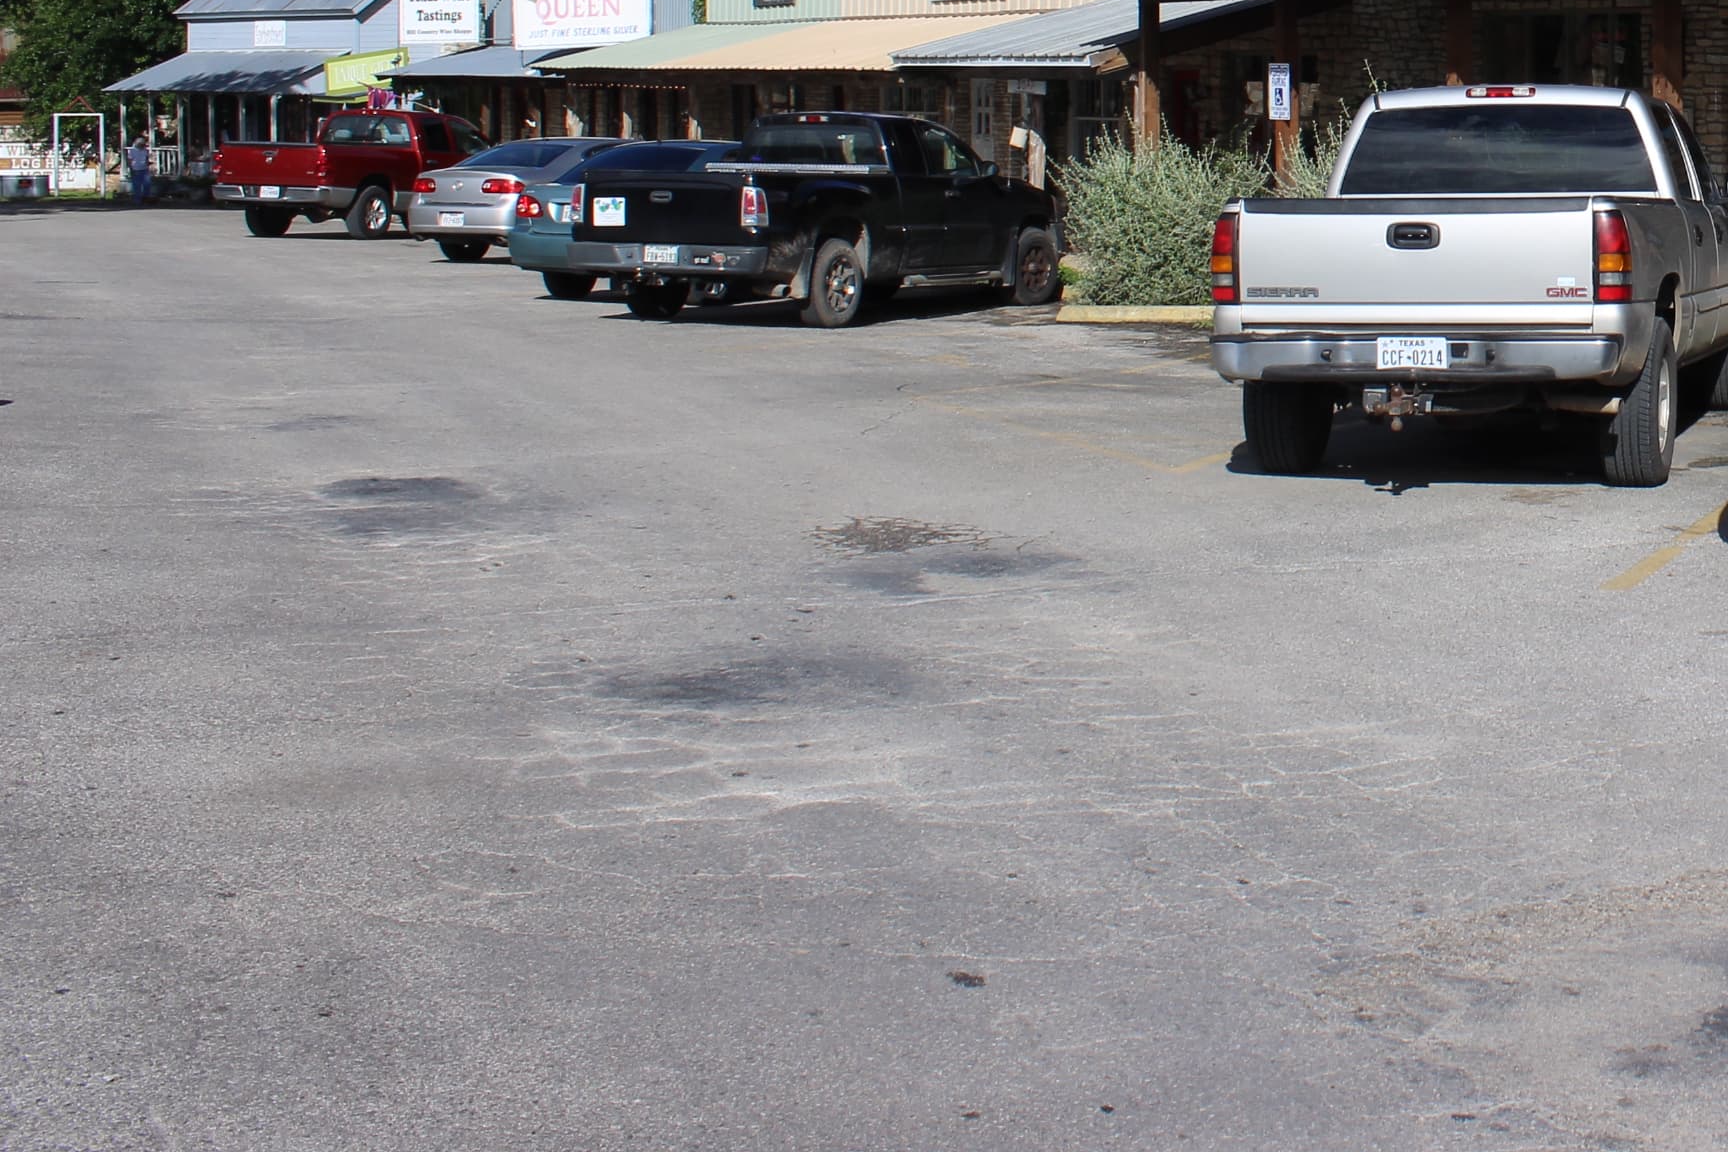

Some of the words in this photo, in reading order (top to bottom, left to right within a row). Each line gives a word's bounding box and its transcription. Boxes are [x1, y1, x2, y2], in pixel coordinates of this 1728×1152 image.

[416, 9, 463, 23] Tastings
[528, 29, 549, 39] JUST
[551, 28, 571, 37] FINE
[12, 158, 41, 169] LOG
[1247, 287, 1320, 298] SIERRA
[1546, 287, 1588, 298] GMC
[1399, 339, 1426, 347] TEXAS
